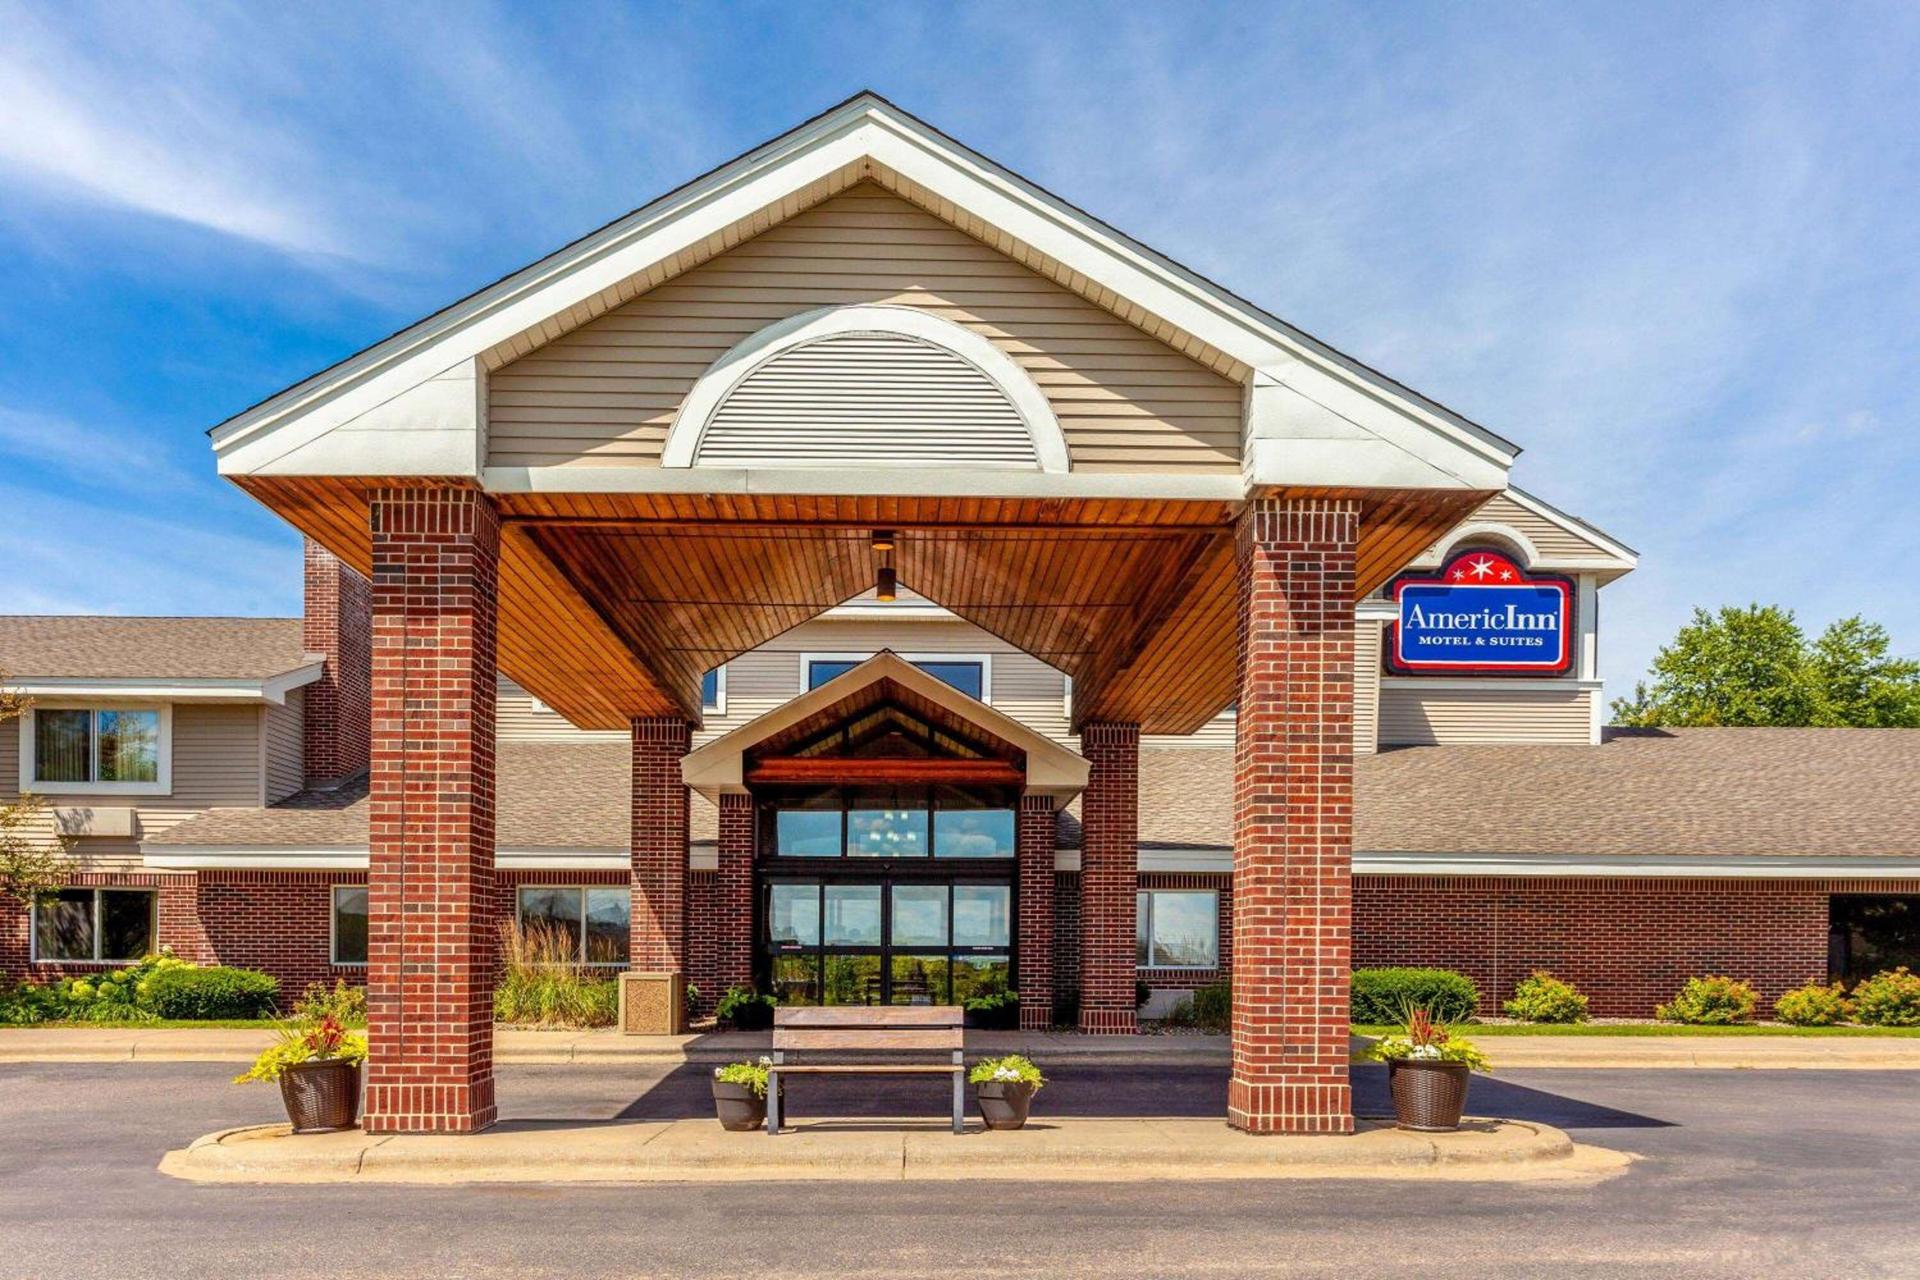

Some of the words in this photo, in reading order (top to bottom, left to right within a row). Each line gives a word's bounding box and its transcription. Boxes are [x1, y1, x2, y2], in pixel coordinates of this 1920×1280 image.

[1405, 603, 1558, 631] AmericInn
[1418, 636, 1471, 645] MOTEL
[1475, 637, 1486, 646] &
[1489, 637, 1543, 646] SUITES
